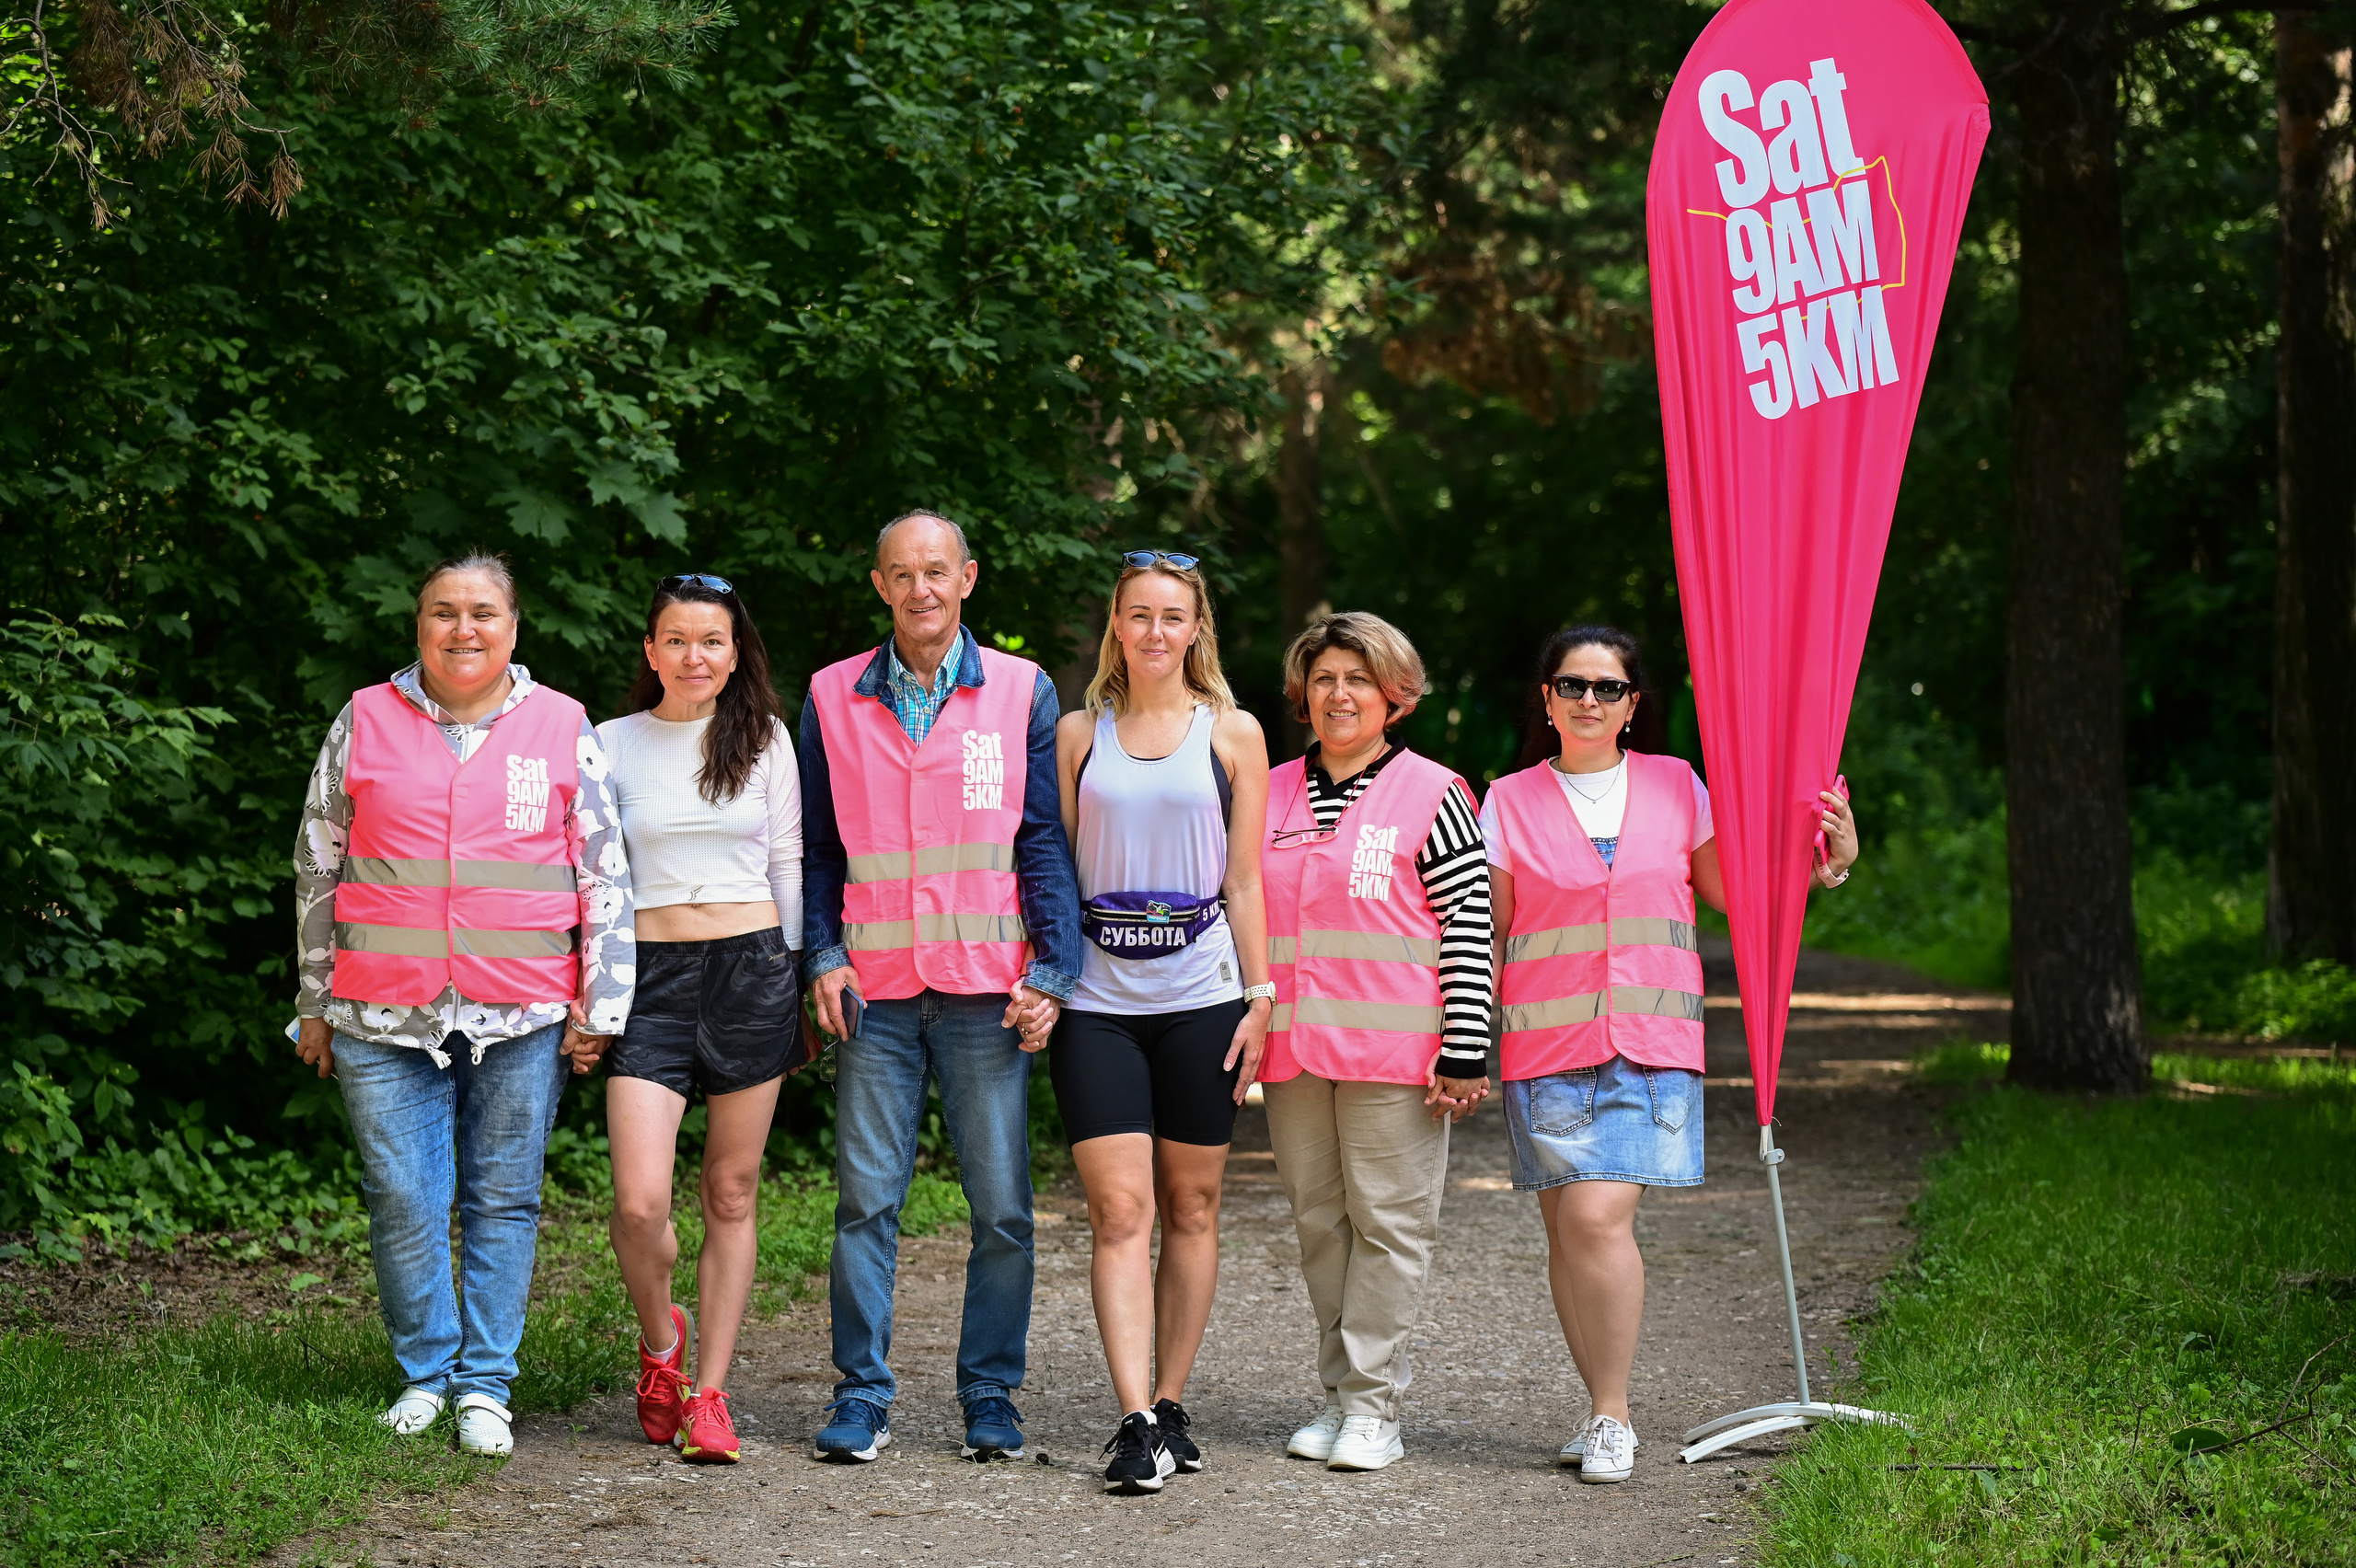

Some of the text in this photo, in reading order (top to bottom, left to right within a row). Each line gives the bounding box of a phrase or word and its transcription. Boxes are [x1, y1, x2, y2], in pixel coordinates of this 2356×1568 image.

[1698, 58, 1866, 208] Sat
[1725, 179, 1879, 314] 9AM
[1736, 285, 1900, 420] 5KM
[962, 730, 1004, 760] Sat
[506, 754, 549, 783] Sat
[962, 758, 1004, 785] 9AM
[506, 779, 549, 808] 9AM
[962, 784, 1004, 811] 5KM
[504, 803, 548, 833] 5KM
[1356, 824, 1400, 854] Sat
[1351, 848, 1394, 877] 9AM
[1348, 871, 1392, 902] 5KM
[1202, 907, 1208, 922] 5
[1099, 926, 1187, 947] СУББОТА
